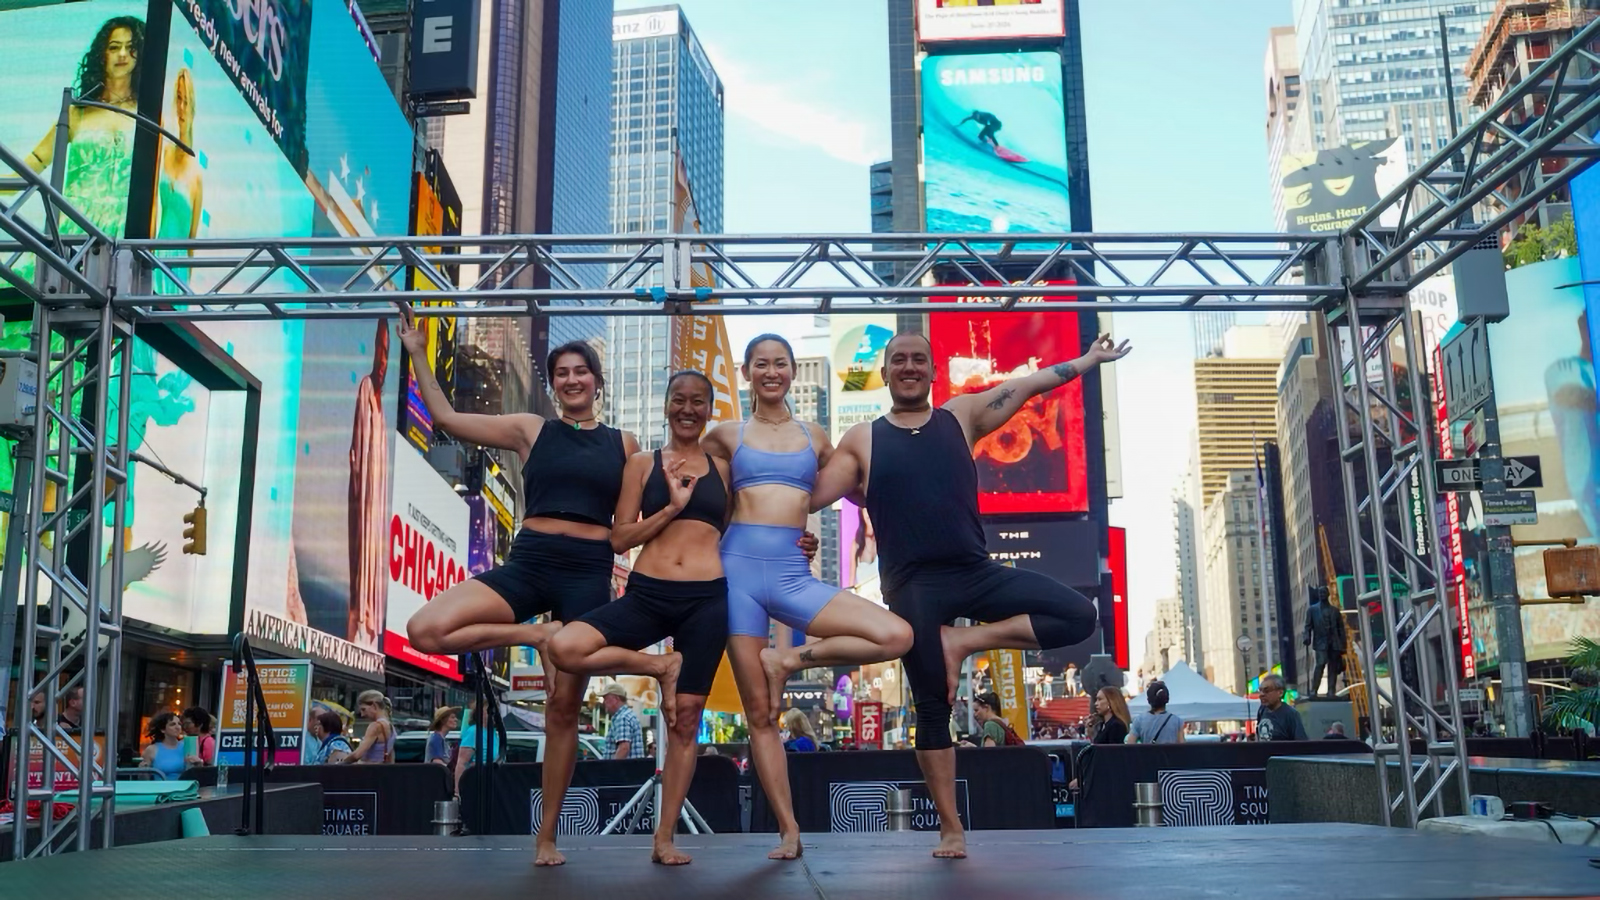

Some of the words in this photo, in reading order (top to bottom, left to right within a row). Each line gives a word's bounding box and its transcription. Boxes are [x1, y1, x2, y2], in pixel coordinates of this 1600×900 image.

[612, 22, 640, 35] anz
[940, 66, 1045, 87] SAMSUNG
[220, 40, 241, 77] new
[240, 71, 271, 122] arrivals
[270, 109, 284, 138] for
[1296, 212, 1335, 225] Brains.
[1336, 206, 1367, 219] Heart
[838, 414, 862, 424] PUBLIC
[1451, 468, 1480, 481] ONE
[1506, 465, 1524, 479] AY
[1411, 487, 1420, 500] off
[1413, 500, 1422, 516] the
[1415, 516, 1426, 556] Embrace
[989, 552, 1041, 560] TRUTH
[246, 609, 309, 653] AMERICAN
[310, 629, 340, 660] EAGLE
[1000, 651, 1017, 709] STICE
[280, 702, 294, 710] FOR
[862, 705, 879, 741] tkts
[280, 735, 300, 747] IN
[1243, 786, 1268, 799] TIM
[912, 797, 936, 810] TIM
[1240, 803, 1268, 817] SQU
[324, 809, 364, 821] TIMES
